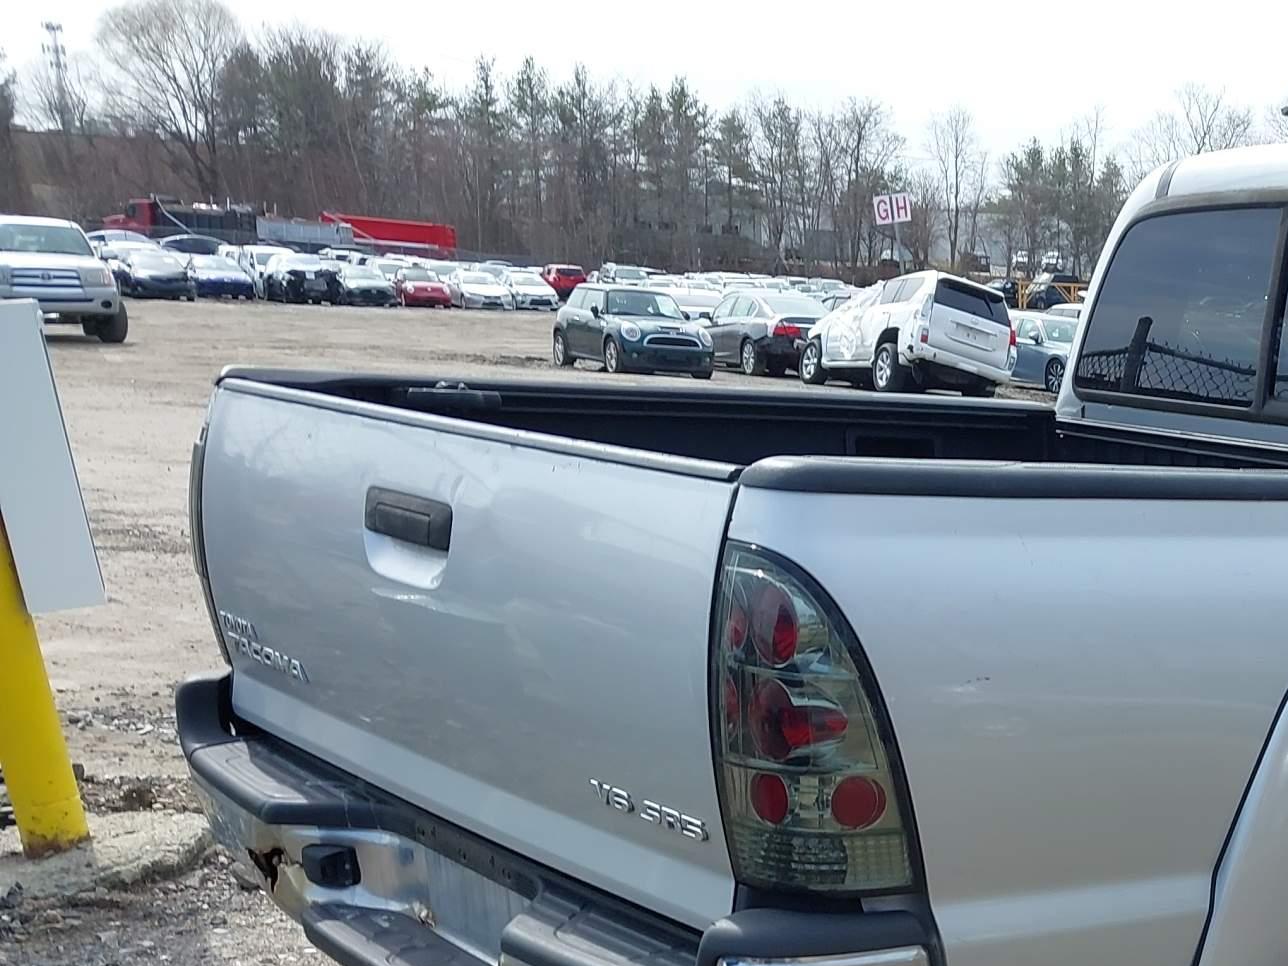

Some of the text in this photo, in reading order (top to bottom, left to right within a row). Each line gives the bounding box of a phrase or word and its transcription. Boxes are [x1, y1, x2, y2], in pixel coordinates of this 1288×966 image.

[219, 609, 257, 640] TOYOTA
[227, 631, 309, 682] TACOMA
[589, 777, 710, 842] V6 SR5
